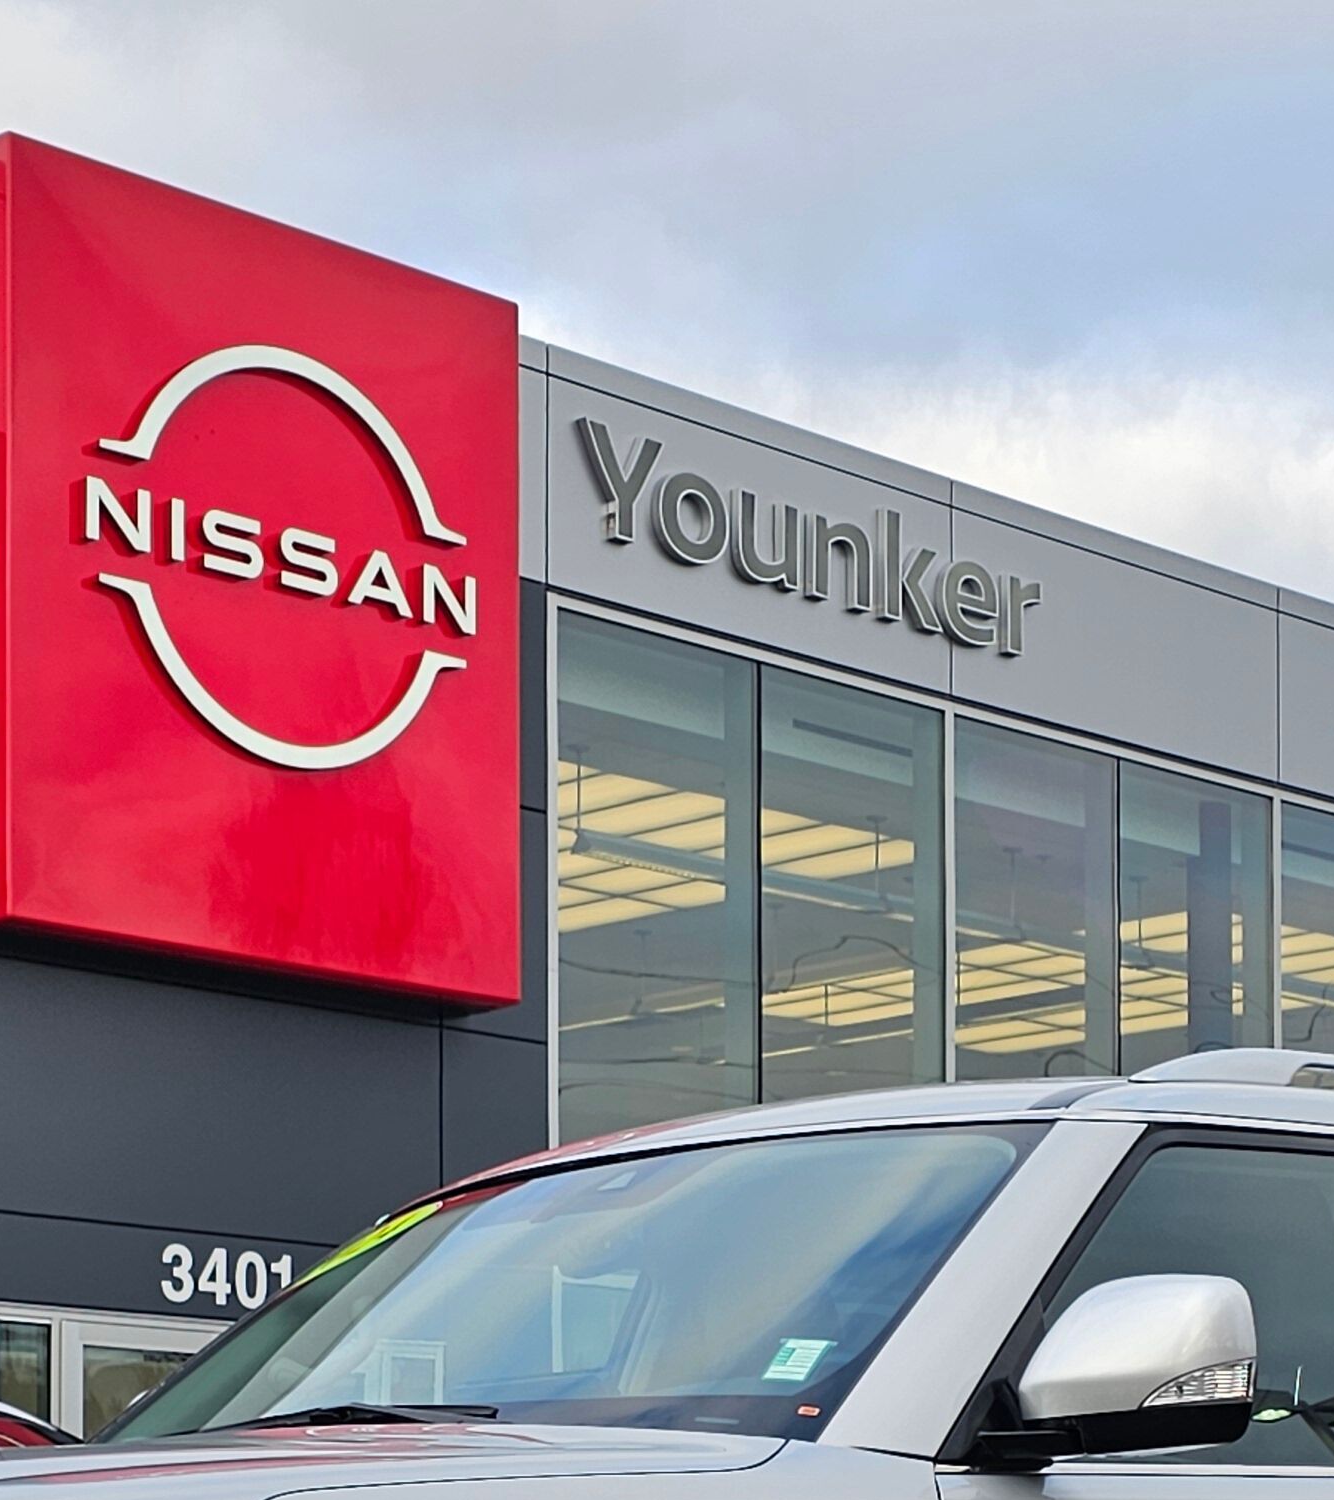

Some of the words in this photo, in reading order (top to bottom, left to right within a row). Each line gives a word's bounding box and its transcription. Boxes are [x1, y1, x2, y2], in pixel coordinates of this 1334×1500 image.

[85, 475, 477, 636] NISSAN
[576, 417, 1041, 656] Younker
[160, 1243, 293, 1310] 3401
